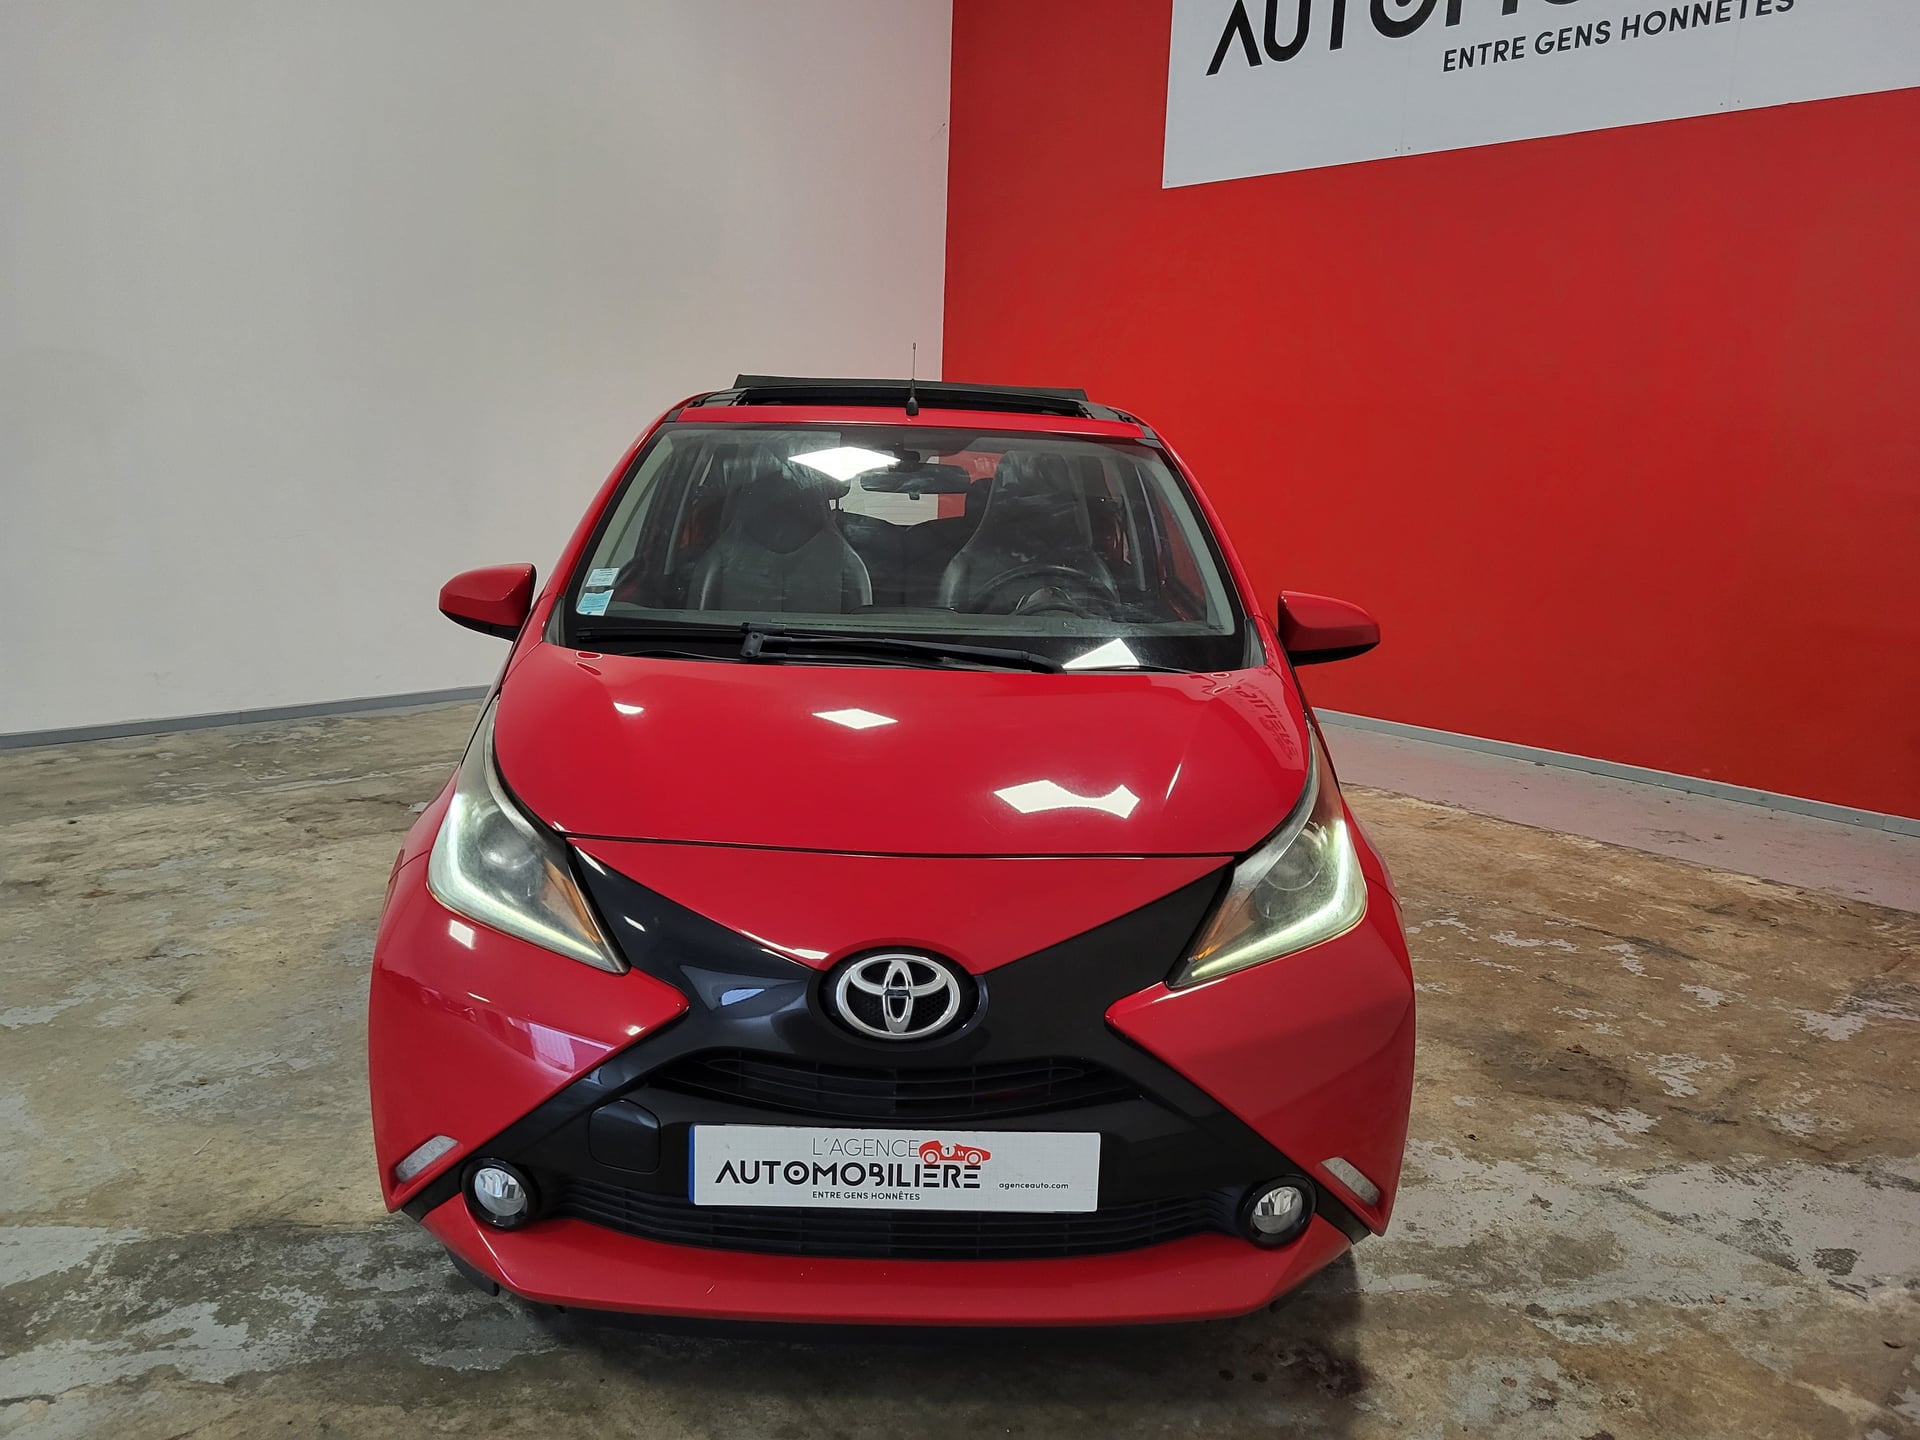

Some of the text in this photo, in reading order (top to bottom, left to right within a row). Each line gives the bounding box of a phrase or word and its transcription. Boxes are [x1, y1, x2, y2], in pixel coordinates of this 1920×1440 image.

[1443, 36, 1528, 73] ENTRE
[1534, 20, 1612, 55] GENS
[812, 1137, 920, 1158] L'AGENCE
[944, 1146, 950, 1155] 1
[998, 1182, 1069, 1191] agenceauto.com
[812, 1190, 921, 1201] ENTRE GENS HONNÊTES
